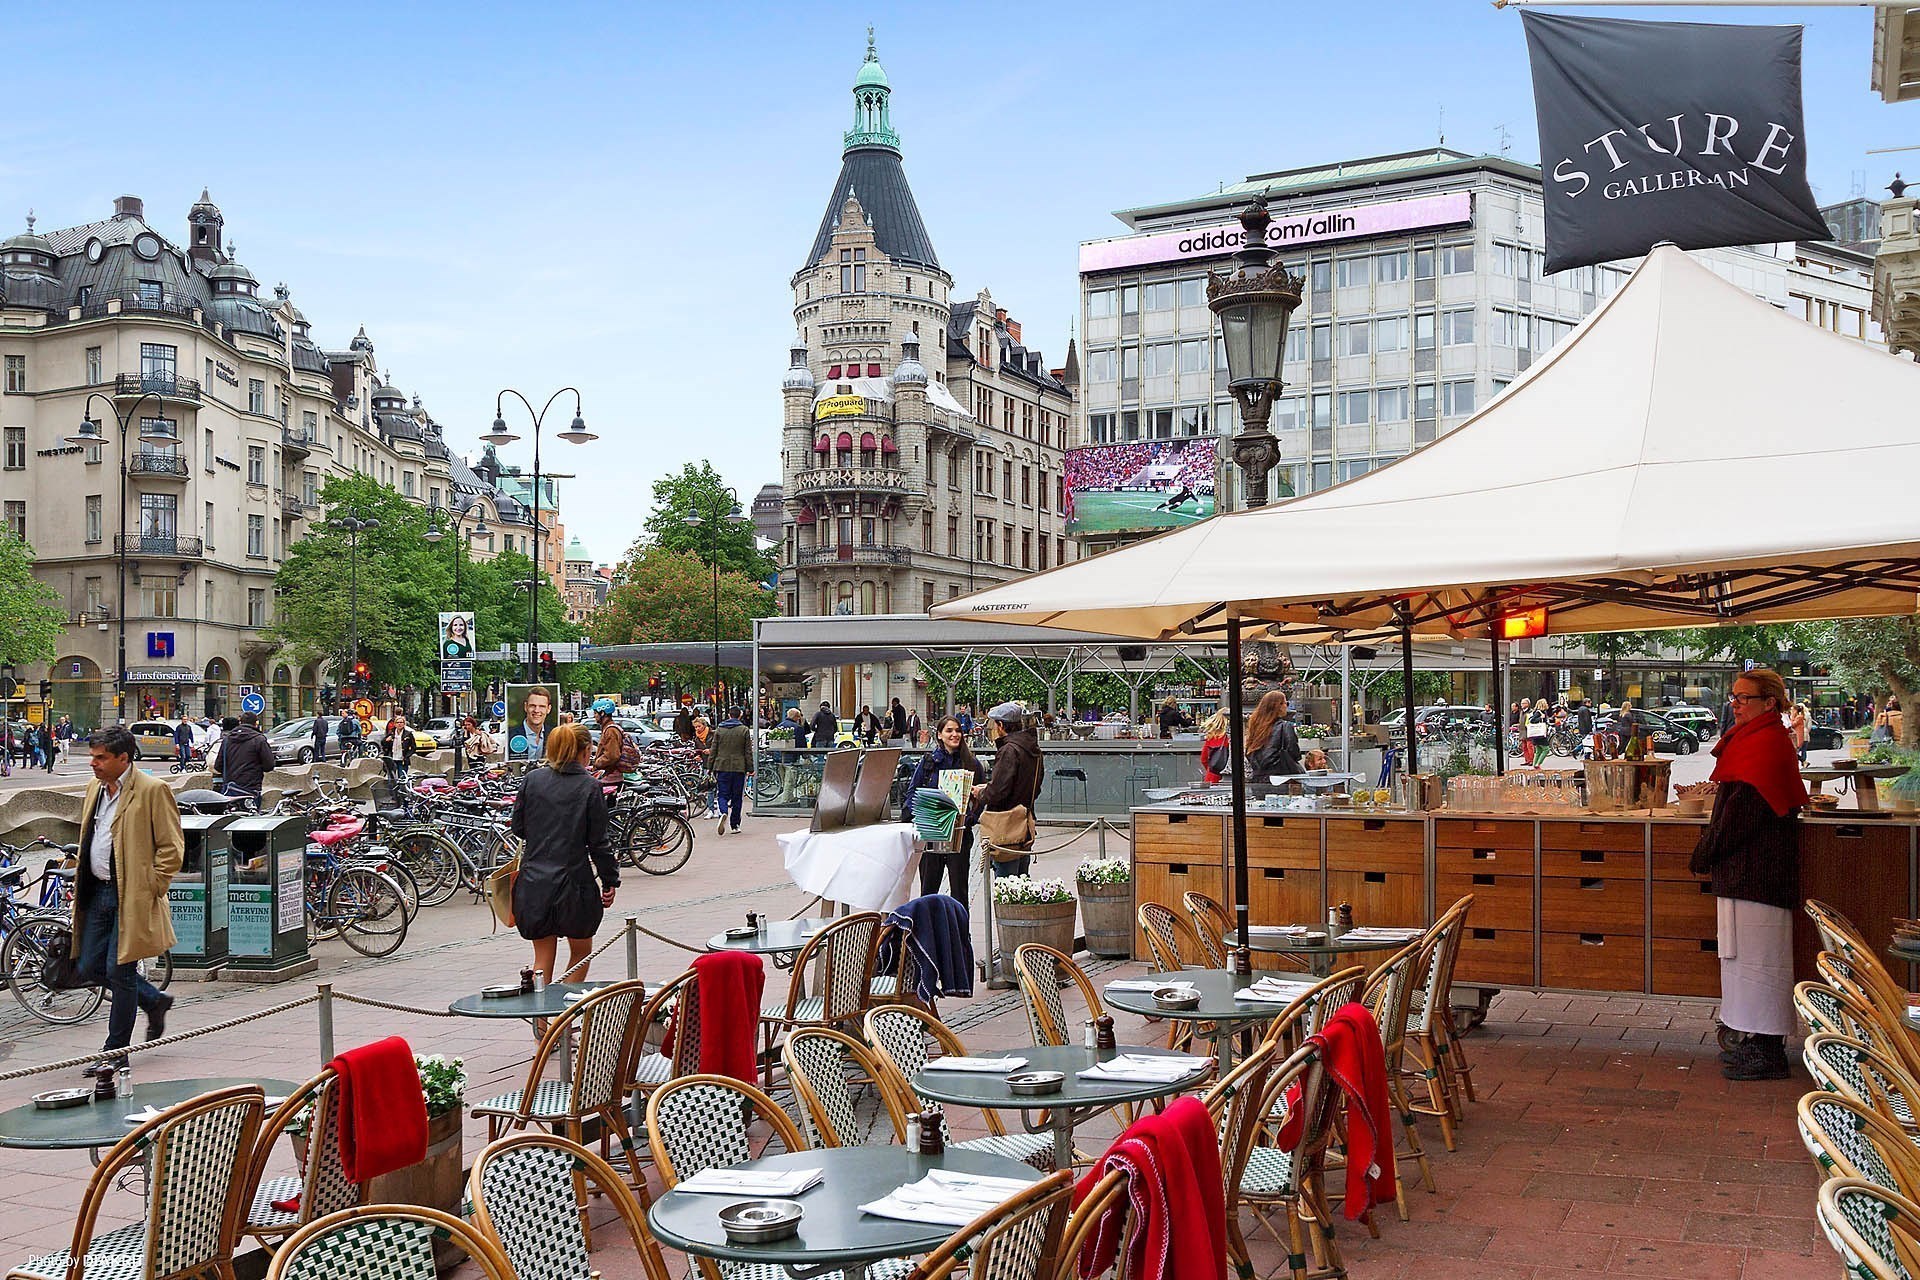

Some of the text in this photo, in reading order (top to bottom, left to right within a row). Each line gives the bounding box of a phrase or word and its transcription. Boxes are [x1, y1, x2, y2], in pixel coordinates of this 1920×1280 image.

[1552, 112, 1795, 199] STURE
[1603, 167, 1749, 200] GALLERAN
[971, 603, 1030, 612] MASTERTENT
[229, 890, 261, 901] metro
[170, 905, 203, 913] TERVINN
[230, 905, 269, 915] ÅTERVINN
[177, 913, 203, 921] METRO
[230, 914, 269, 923] DIN METRO
